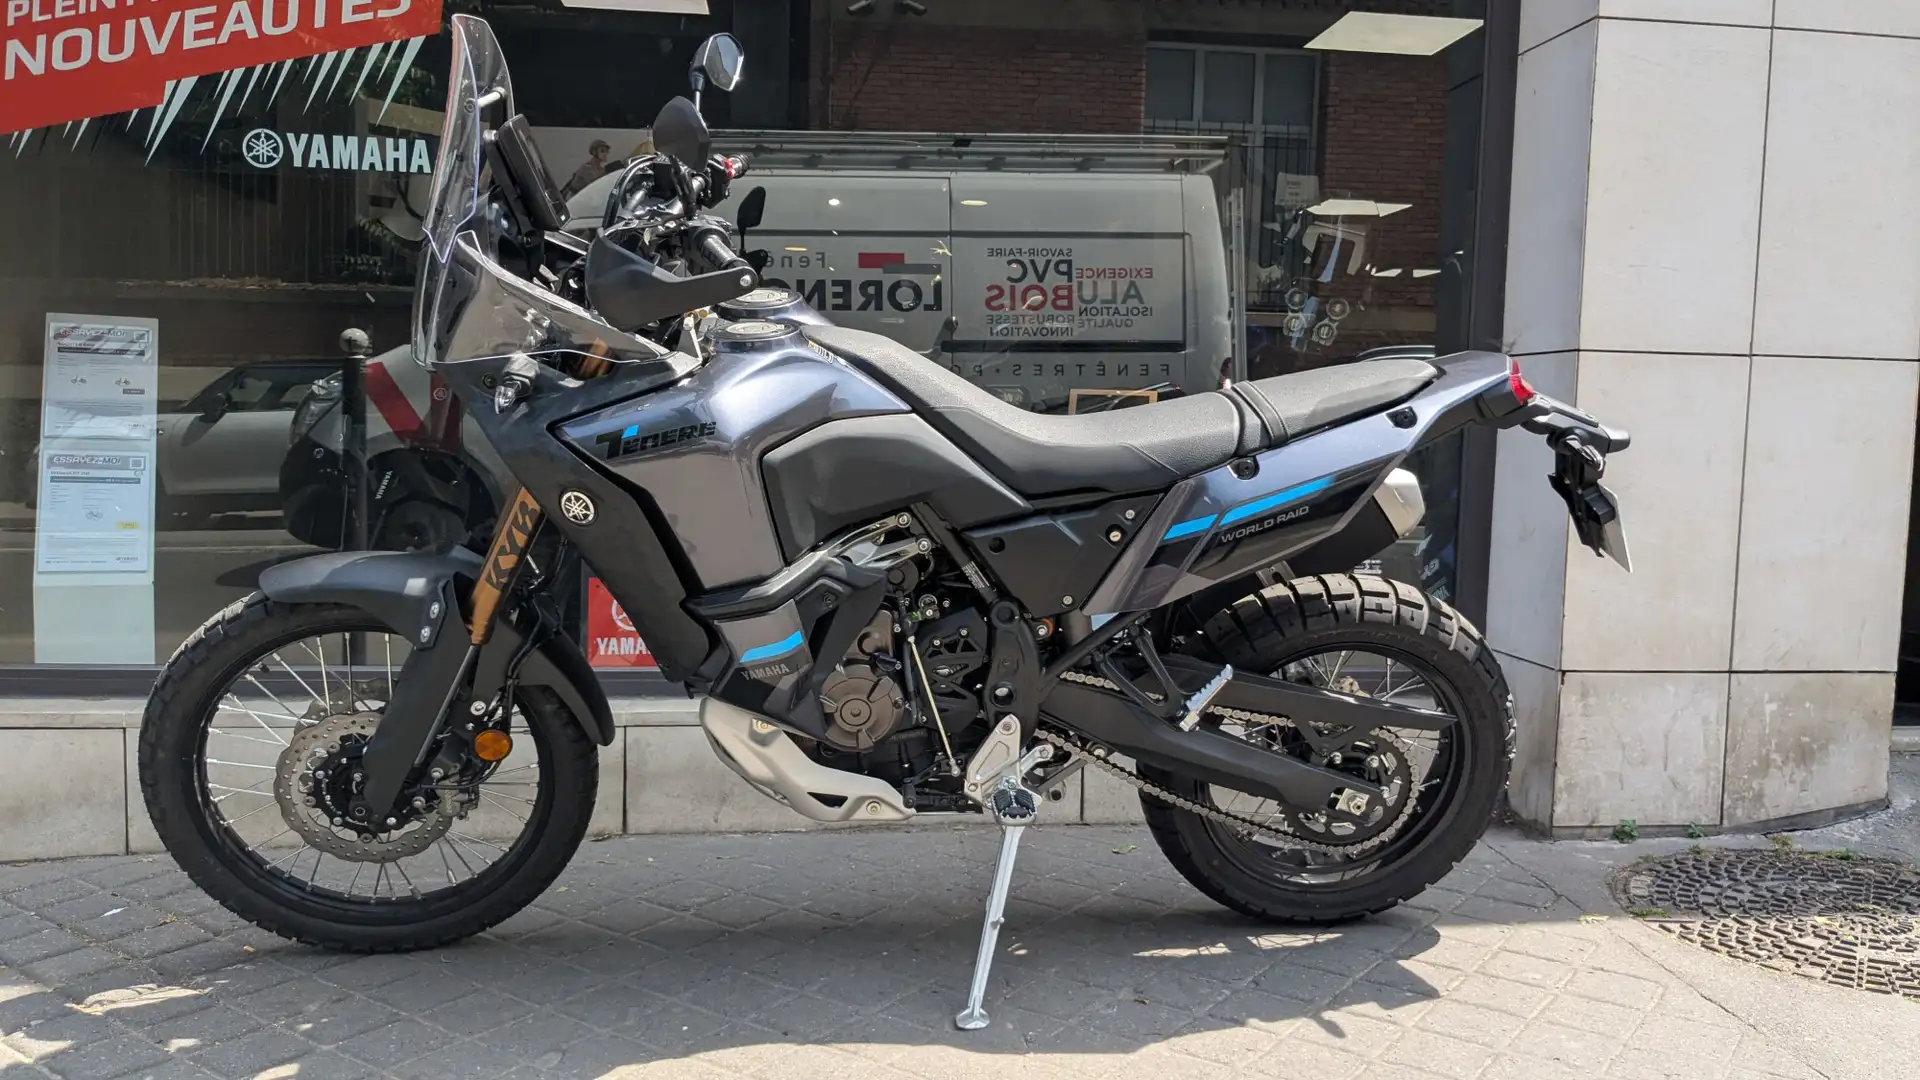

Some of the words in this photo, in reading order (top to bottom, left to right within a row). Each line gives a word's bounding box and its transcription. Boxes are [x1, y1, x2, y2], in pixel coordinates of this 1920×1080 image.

[286, 133, 432, 174] YAMAHA
[1221, 519, 1274, 543] WORLD
[1276, 506, 1309, 525] RAID
[741, 663, 790, 681] YAMAHA
